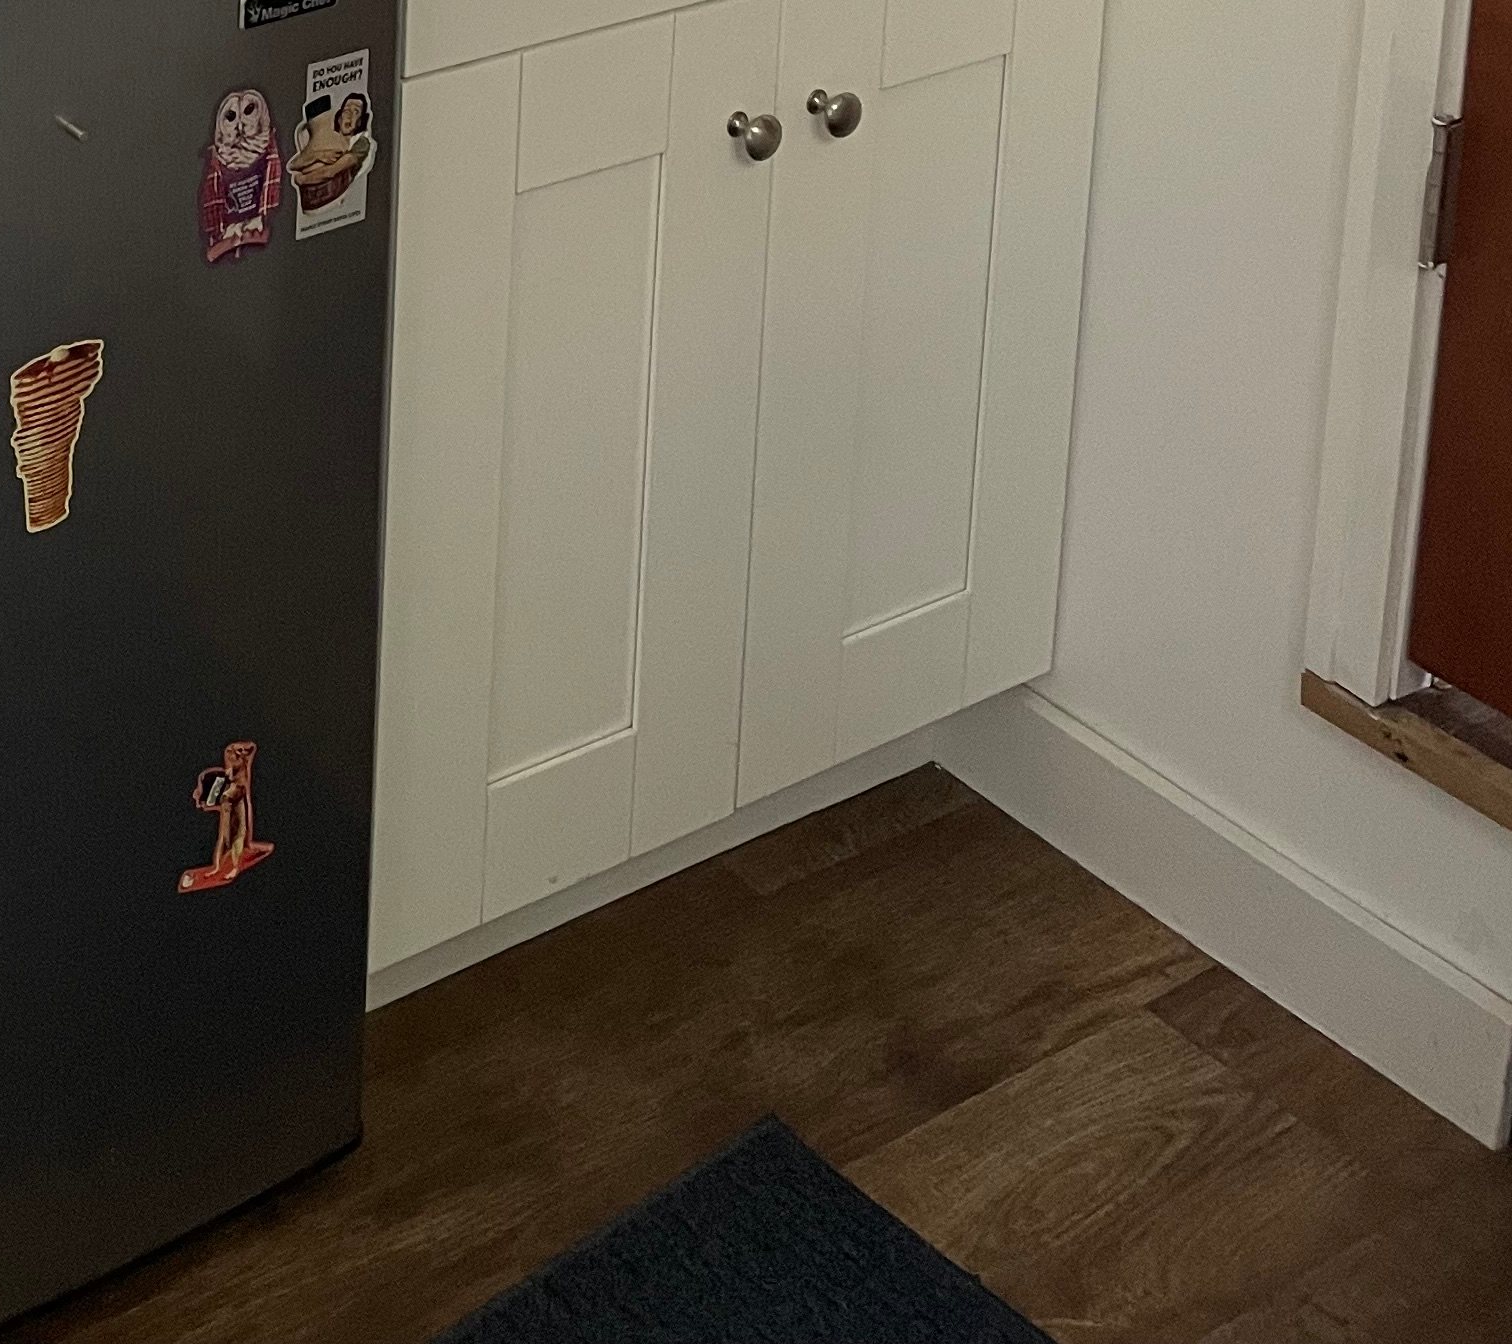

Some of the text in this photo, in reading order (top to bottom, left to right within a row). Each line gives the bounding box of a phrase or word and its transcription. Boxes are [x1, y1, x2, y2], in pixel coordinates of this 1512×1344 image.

[261, 2, 300, 21] Magic
[312, 68, 325, 80] DO
[312, 69, 363, 92] ENOUGH?
